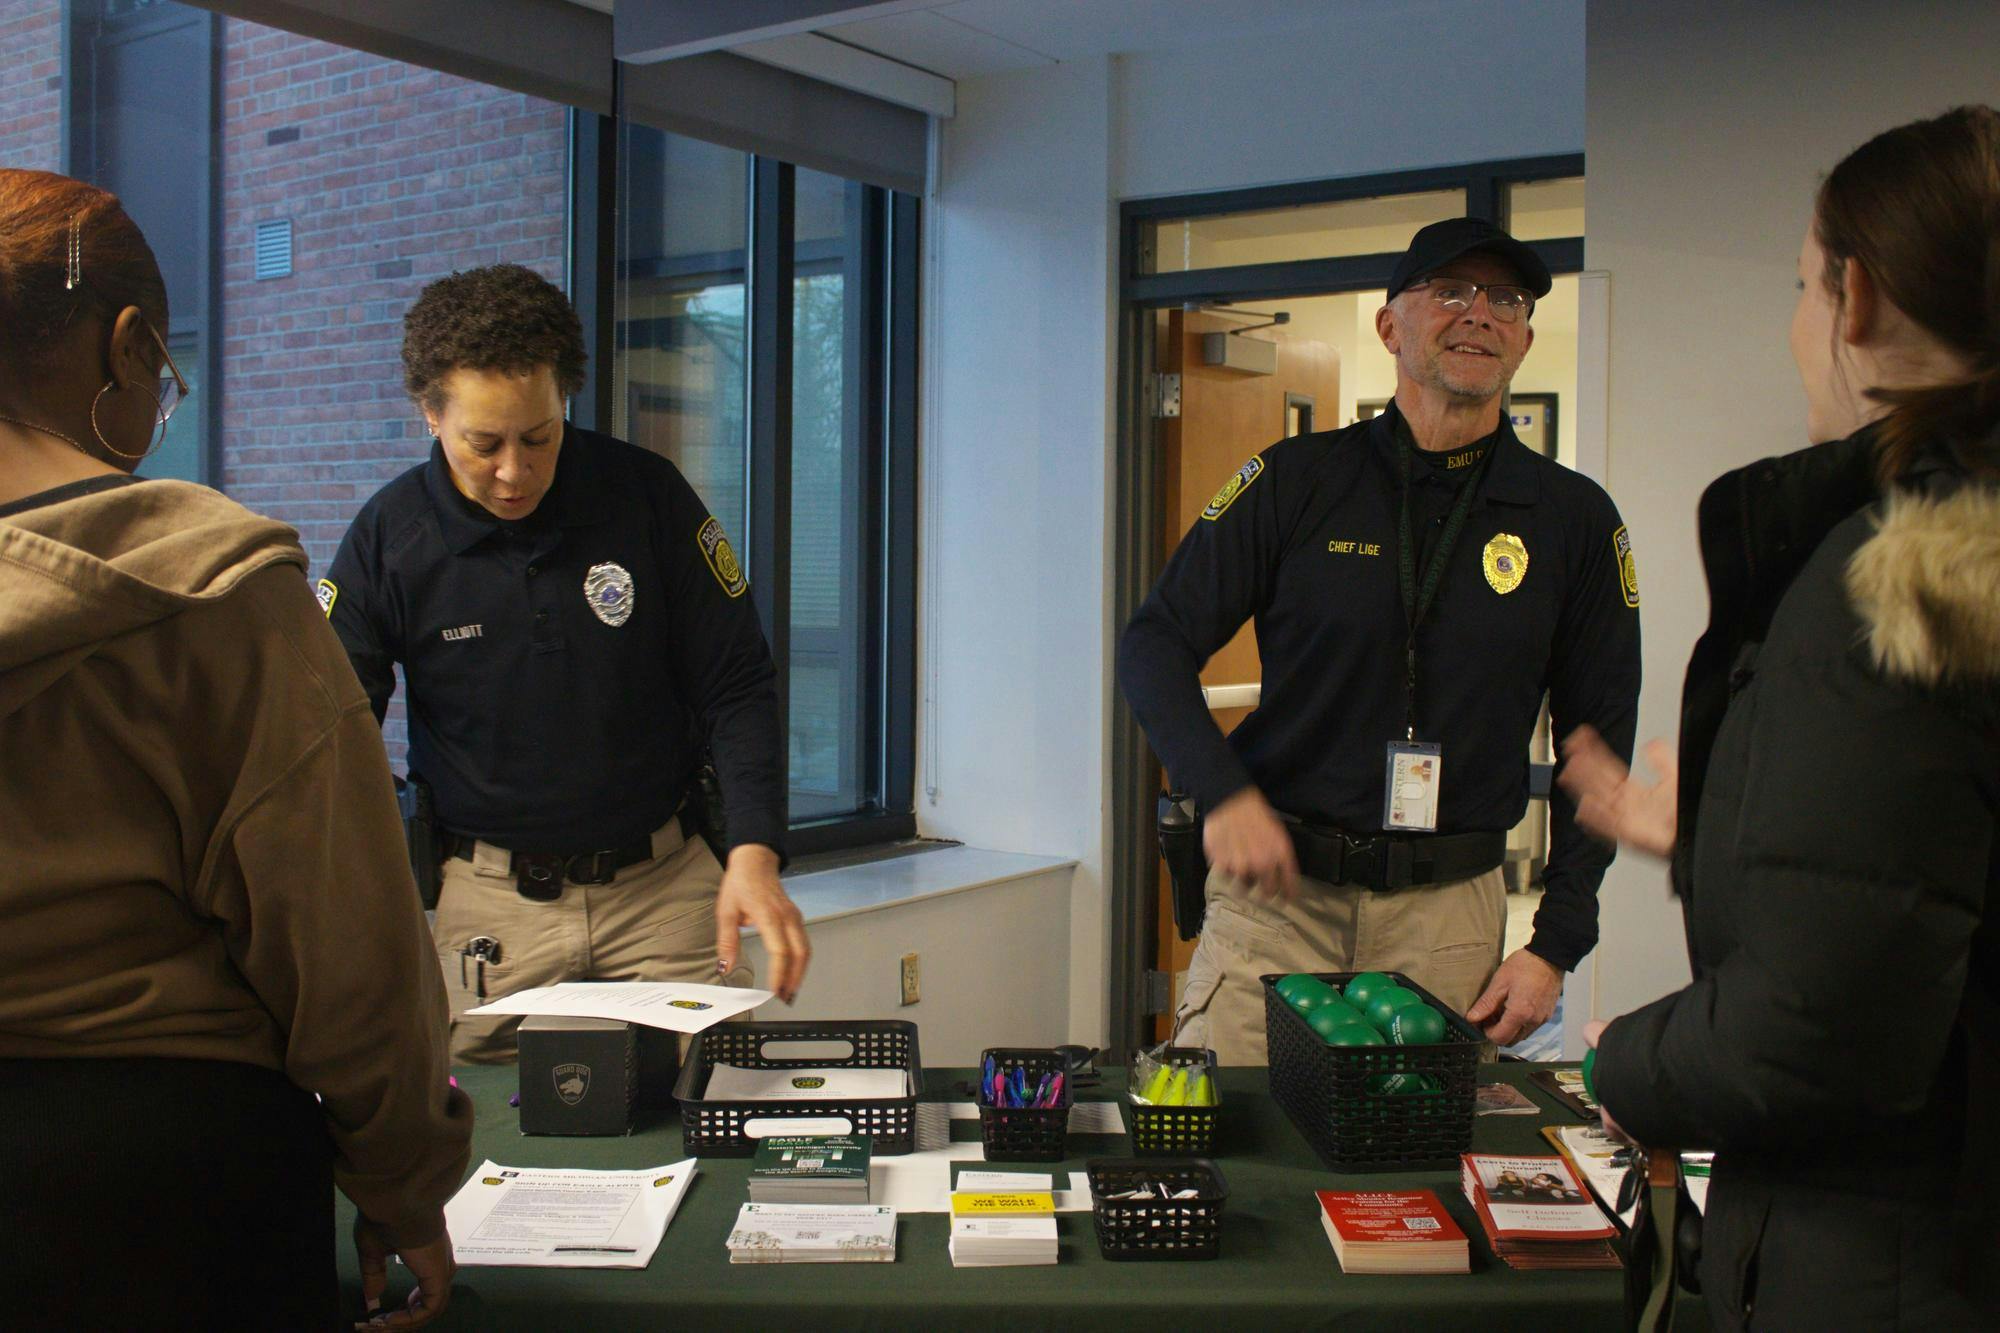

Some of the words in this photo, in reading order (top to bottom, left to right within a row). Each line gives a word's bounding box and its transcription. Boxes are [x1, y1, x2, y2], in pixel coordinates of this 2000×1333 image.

[1446, 451, 1473, 470] EMU
[1328, 540, 1356, 553] CHIEF
[1358, 542, 1381, 556] LIGE
[441, 624, 483, 640] ELLIOTT
[556, 1065, 575, 1076] GUARD
[576, 1066, 588, 1076] DOG
